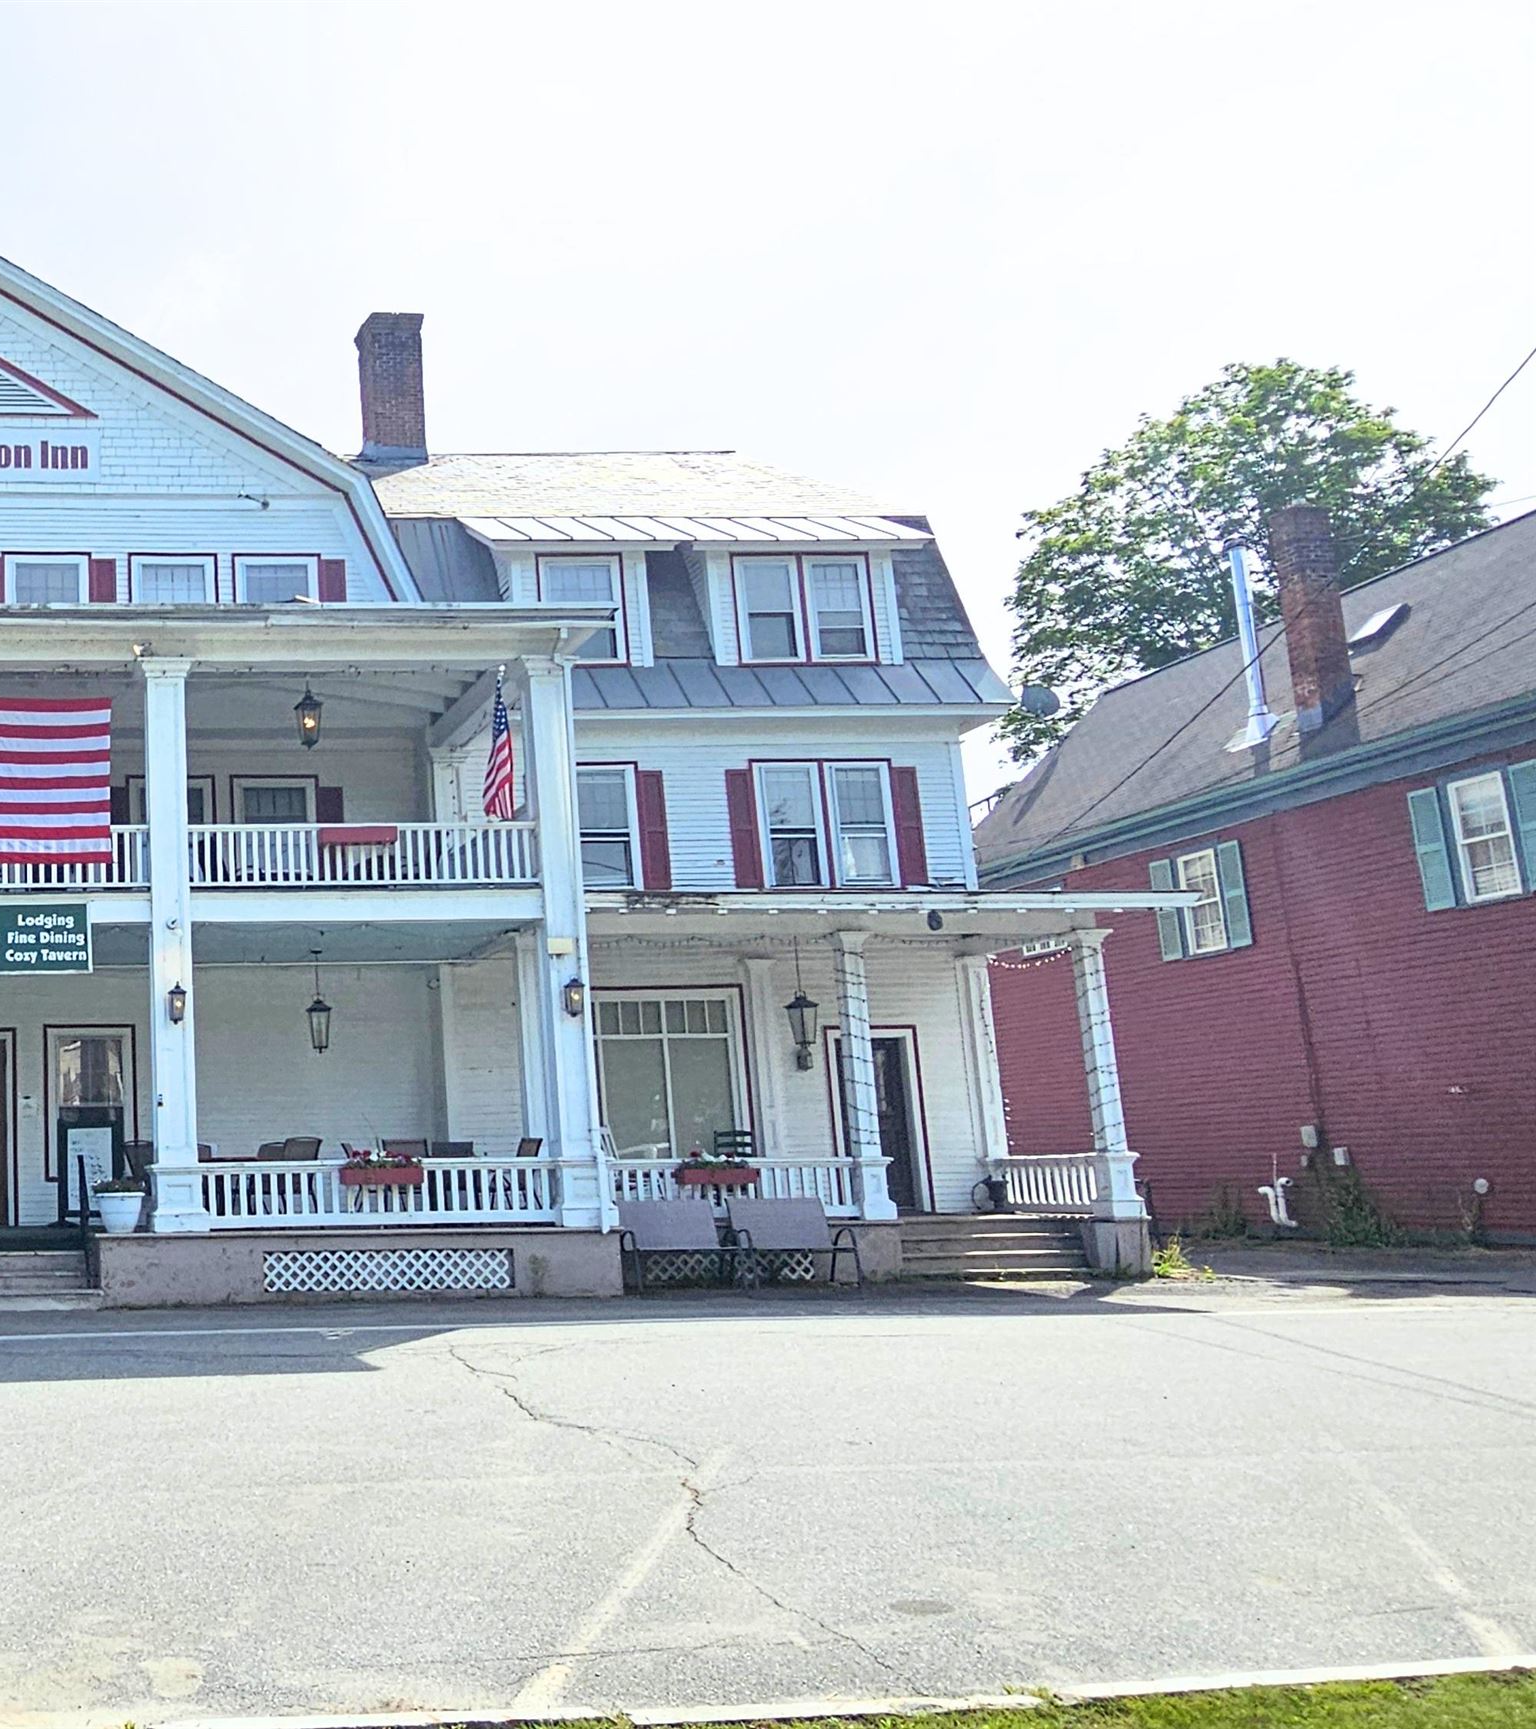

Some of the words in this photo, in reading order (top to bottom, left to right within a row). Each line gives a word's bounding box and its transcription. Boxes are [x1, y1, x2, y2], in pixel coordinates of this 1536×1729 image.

[40, 440, 89, 469] Inn
[17, 914, 75, 929] Lodging
[7, 931, 36, 944] Fine
[39, 931, 85, 946] Dining
[5, 949, 39, 965] Cozy
[40, 949, 88, 962] Tavern
